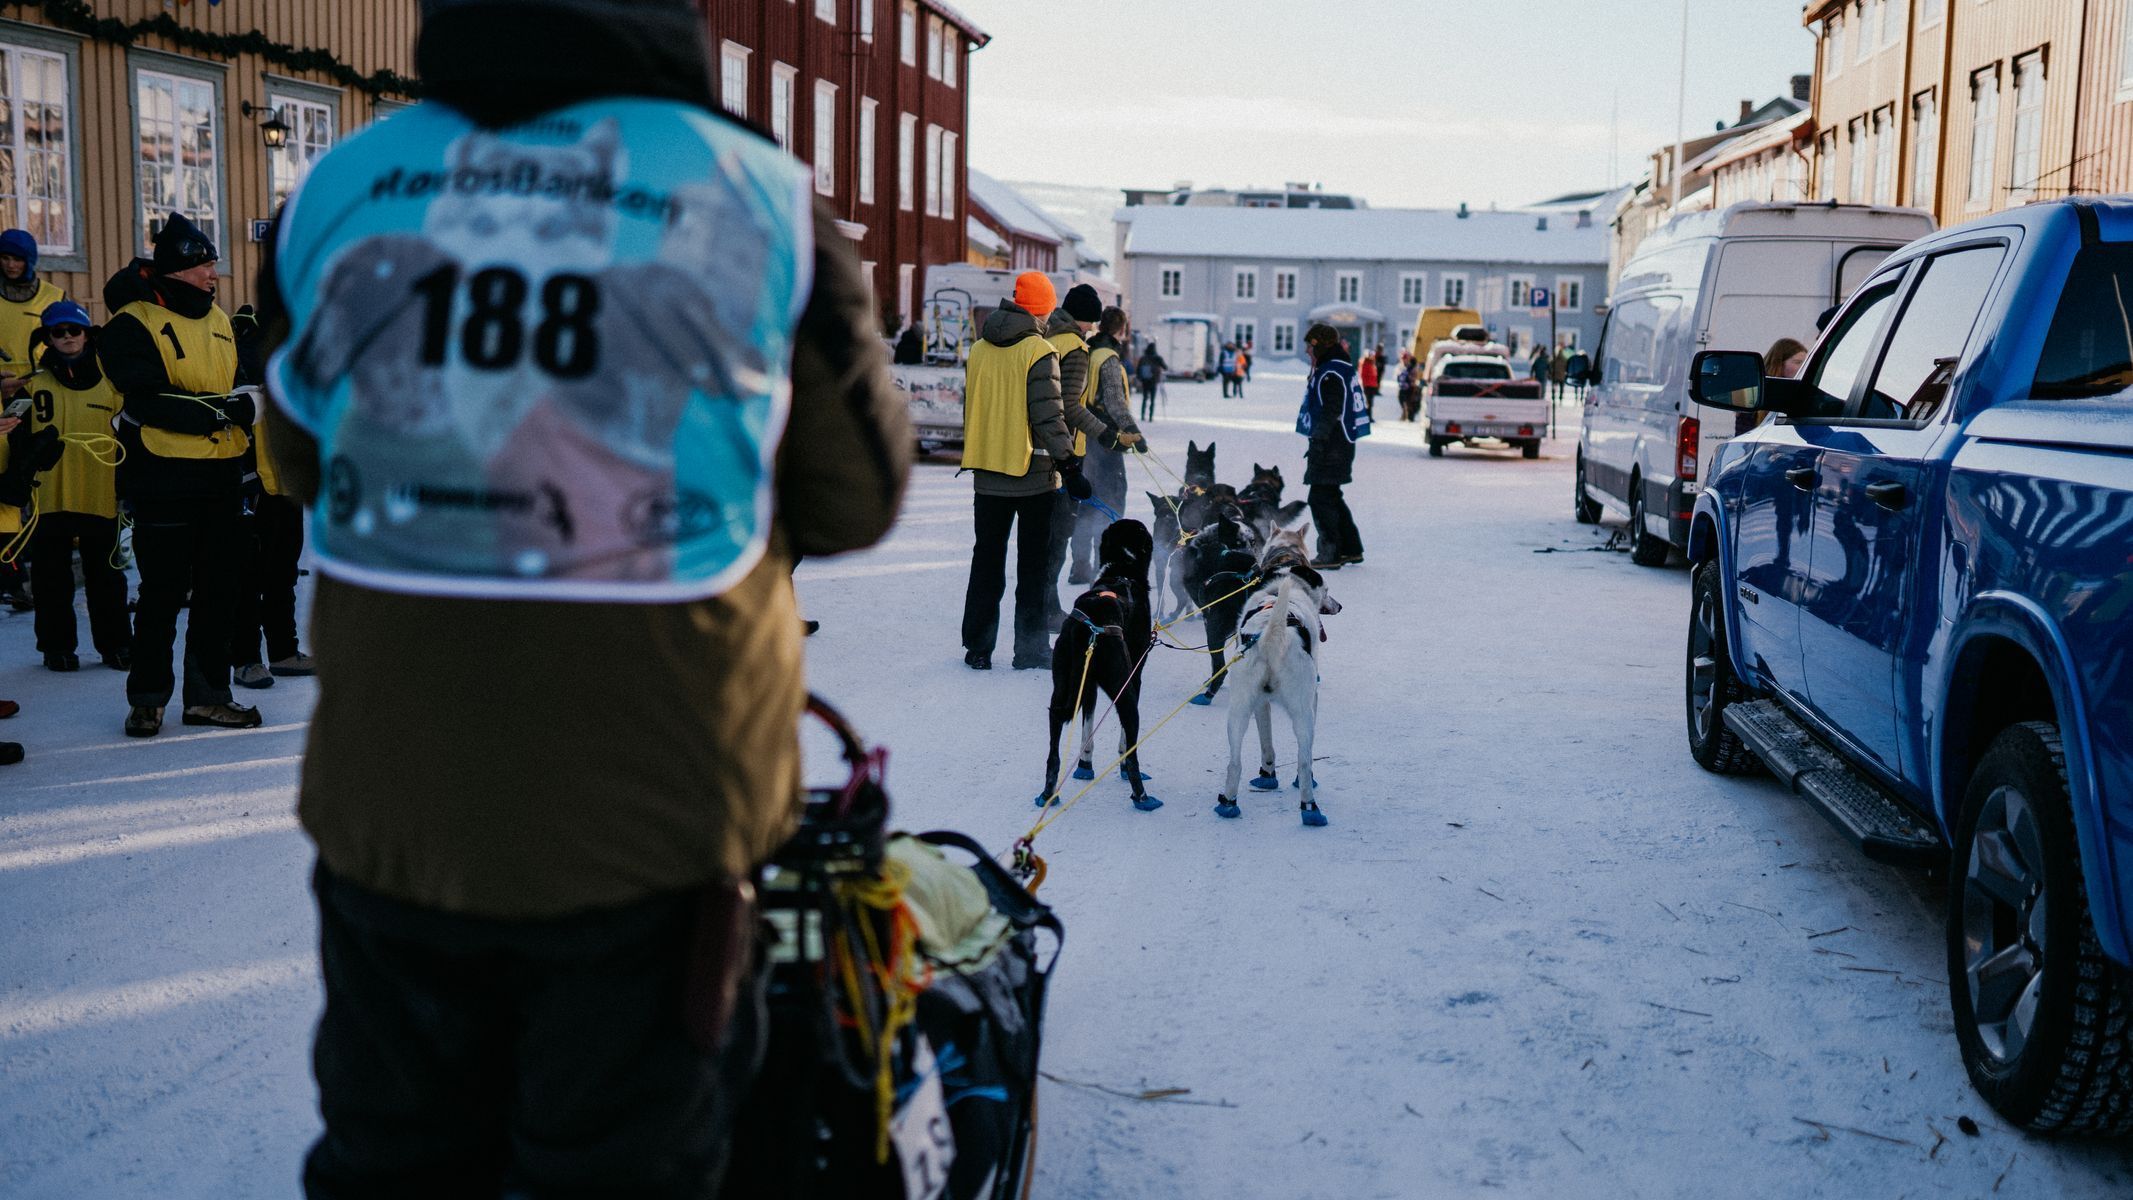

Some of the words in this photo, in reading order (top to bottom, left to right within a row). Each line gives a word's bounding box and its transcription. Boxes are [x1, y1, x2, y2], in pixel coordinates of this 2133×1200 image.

[259, 224, 267, 237] P
[1533, 290, 1544, 305] P
[411, 259, 600, 379] 188
[160, 321, 185, 360] 1
[34, 390, 54, 423] 9
